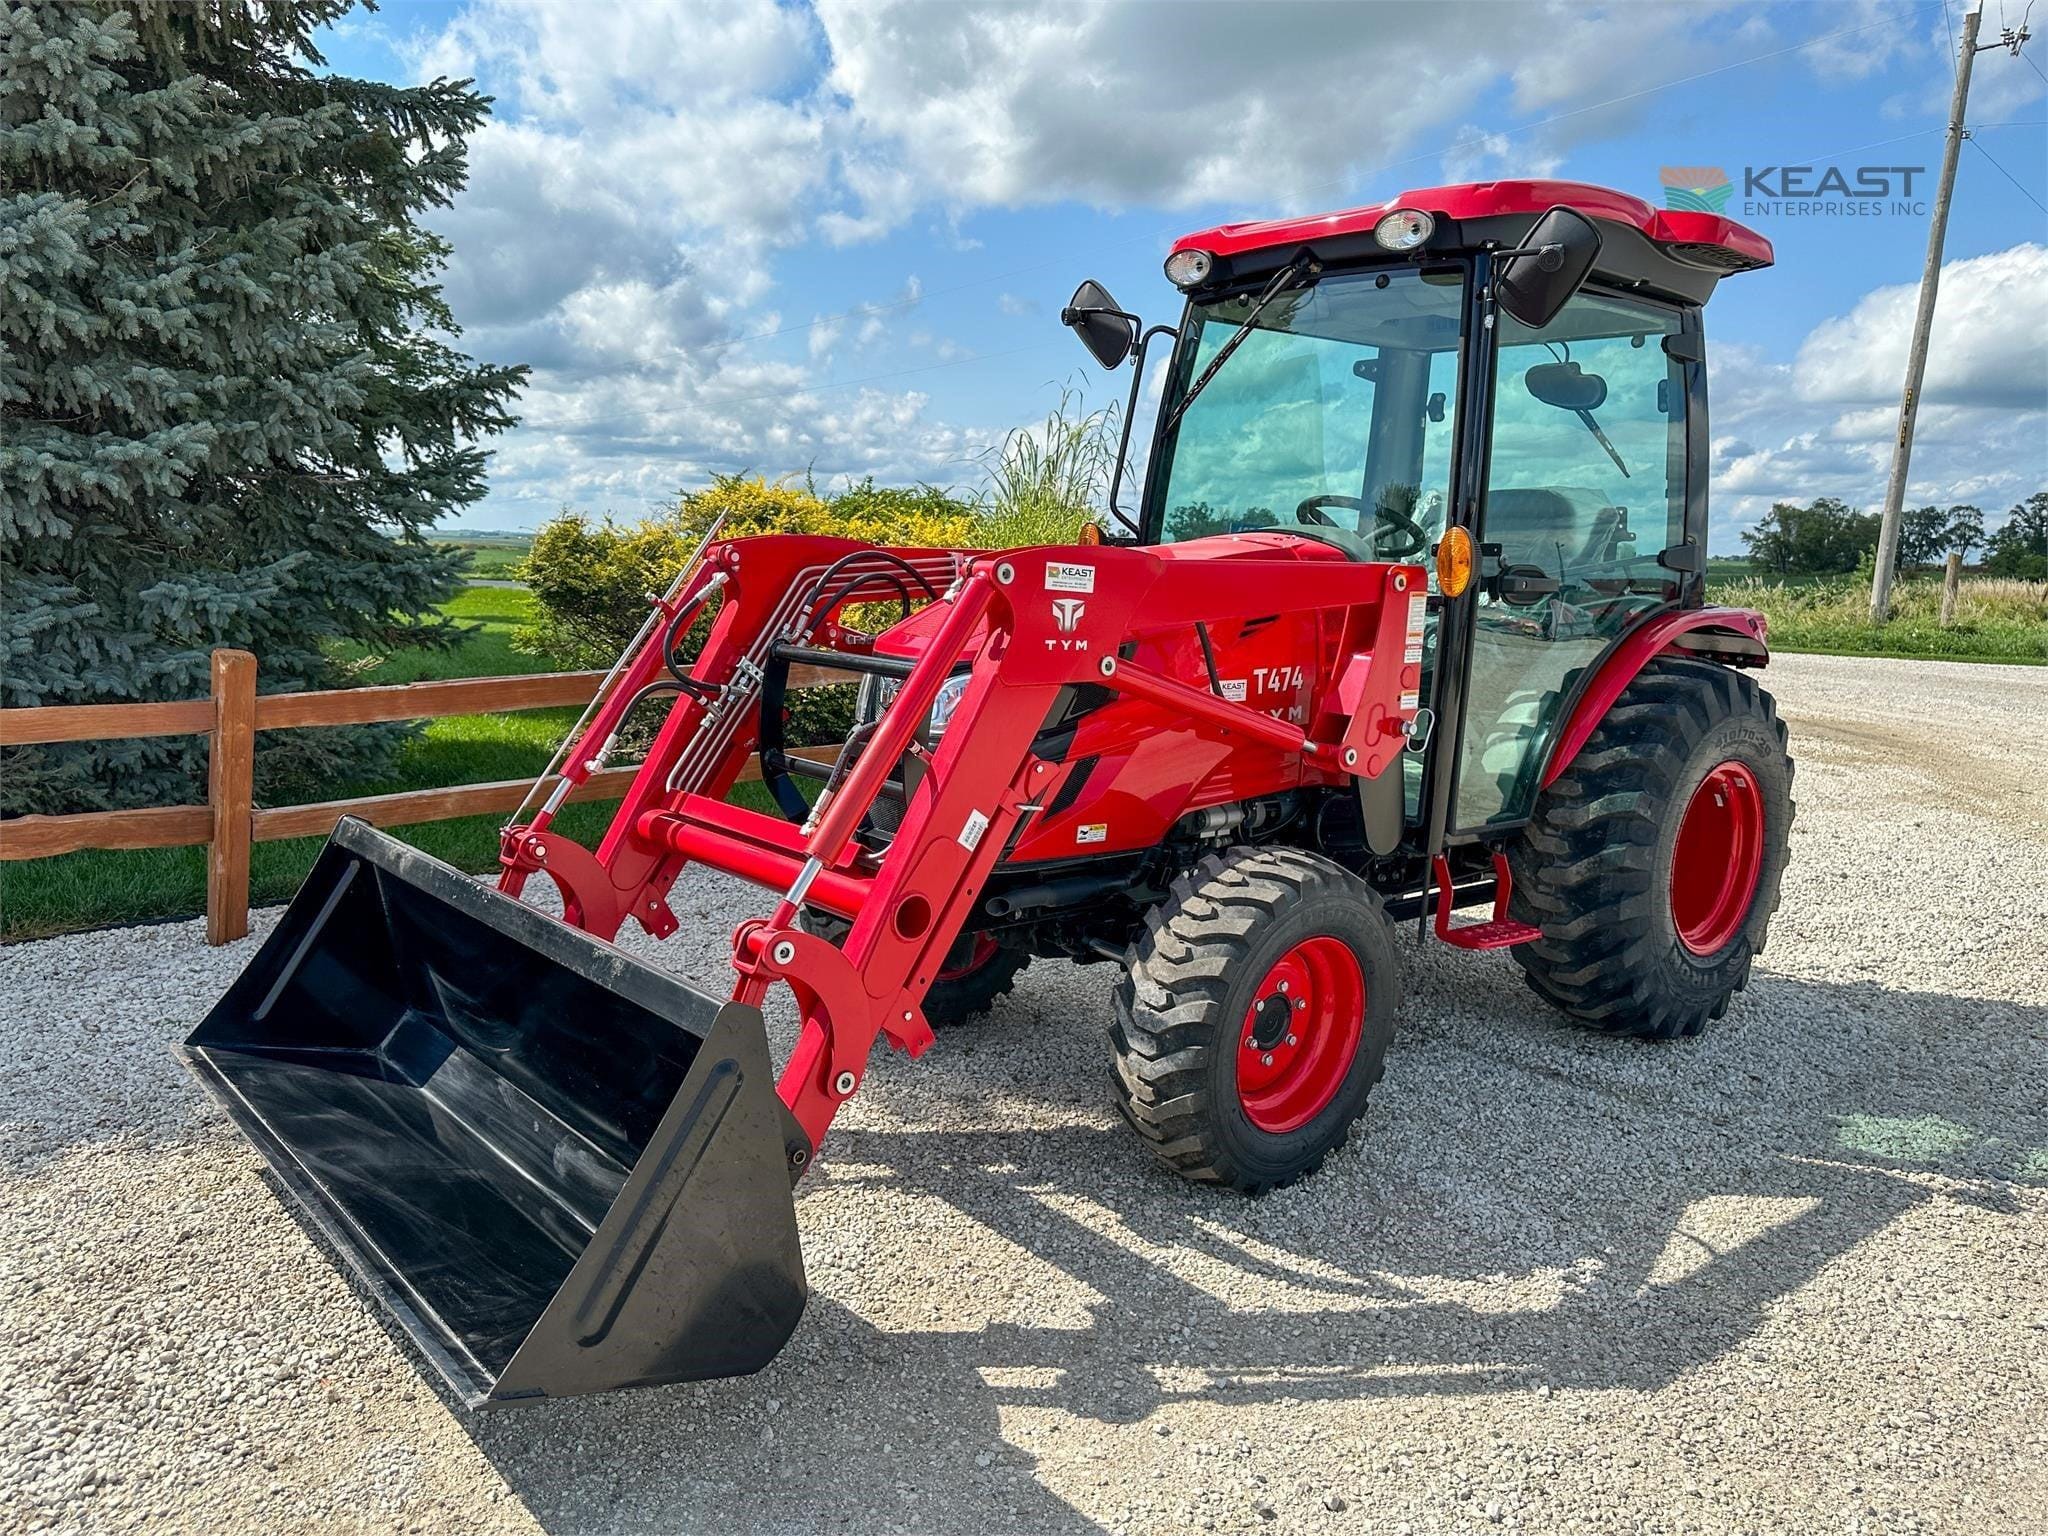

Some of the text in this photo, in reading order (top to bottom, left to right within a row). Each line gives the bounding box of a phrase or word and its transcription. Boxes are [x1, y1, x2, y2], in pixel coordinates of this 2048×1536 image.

[1061, 567, 1093, 577] KEAST
[1045, 639, 1088, 651] TYM
[1222, 682, 1245, 690] KEAST
[1253, 666, 1304, 695] T474
[1256, 705, 1303, 722] YM
